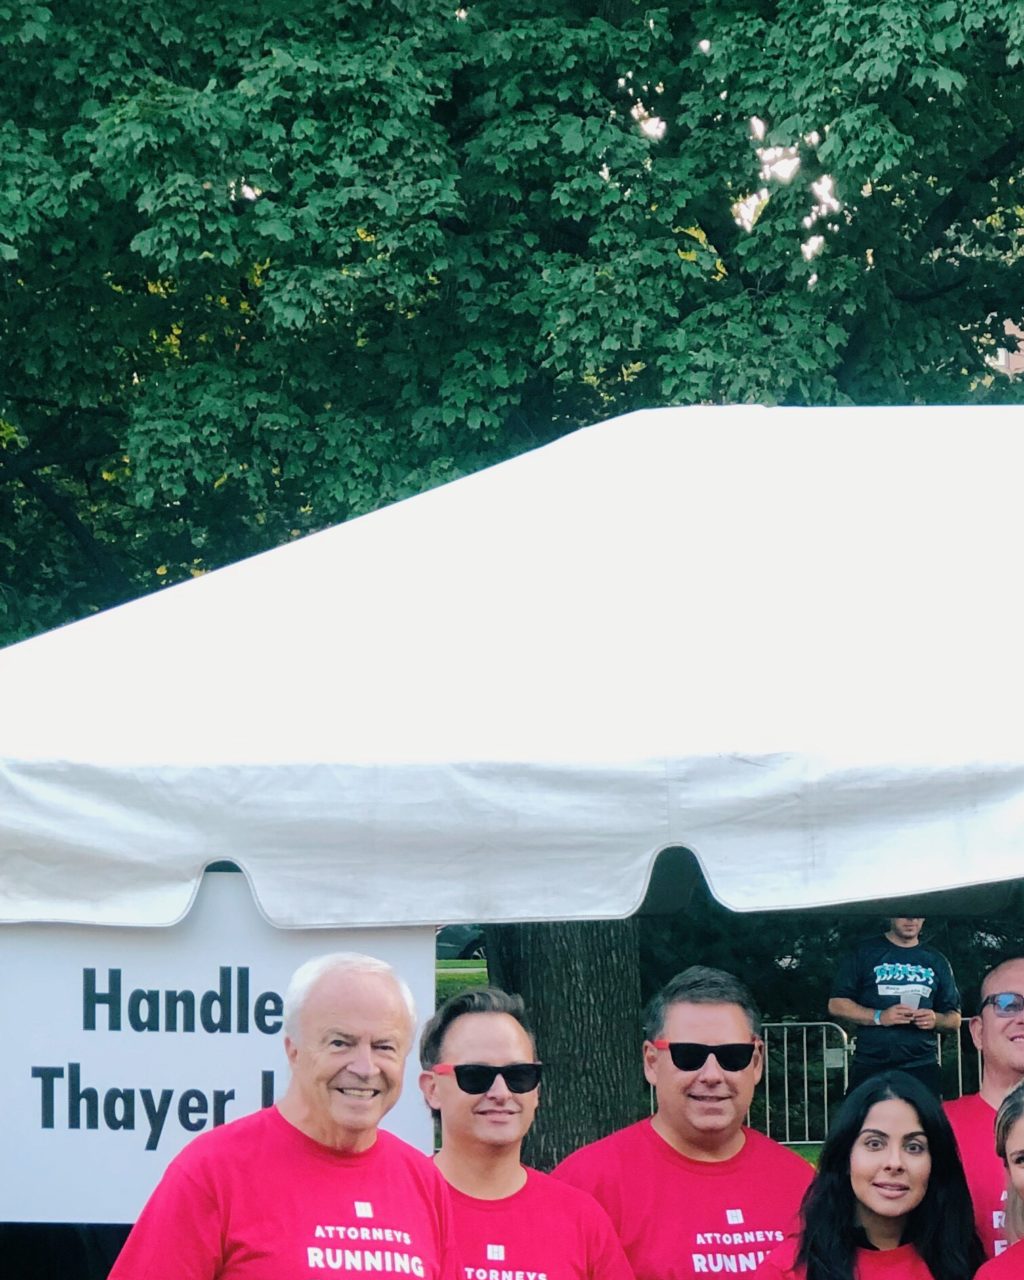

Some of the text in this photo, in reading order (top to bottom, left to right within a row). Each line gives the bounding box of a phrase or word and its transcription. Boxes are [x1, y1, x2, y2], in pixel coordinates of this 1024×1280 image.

[82, 966, 284, 1035] Handle
[31, 1063, 235, 1151] Thayer
[315, 1226, 411, 1244] ATTORNEYS
[697, 1231, 783, 1244] ATTORNEYS
[307, 1247, 424, 1277] RUNNING
[692, 1251, 769, 1272] RUNNI
